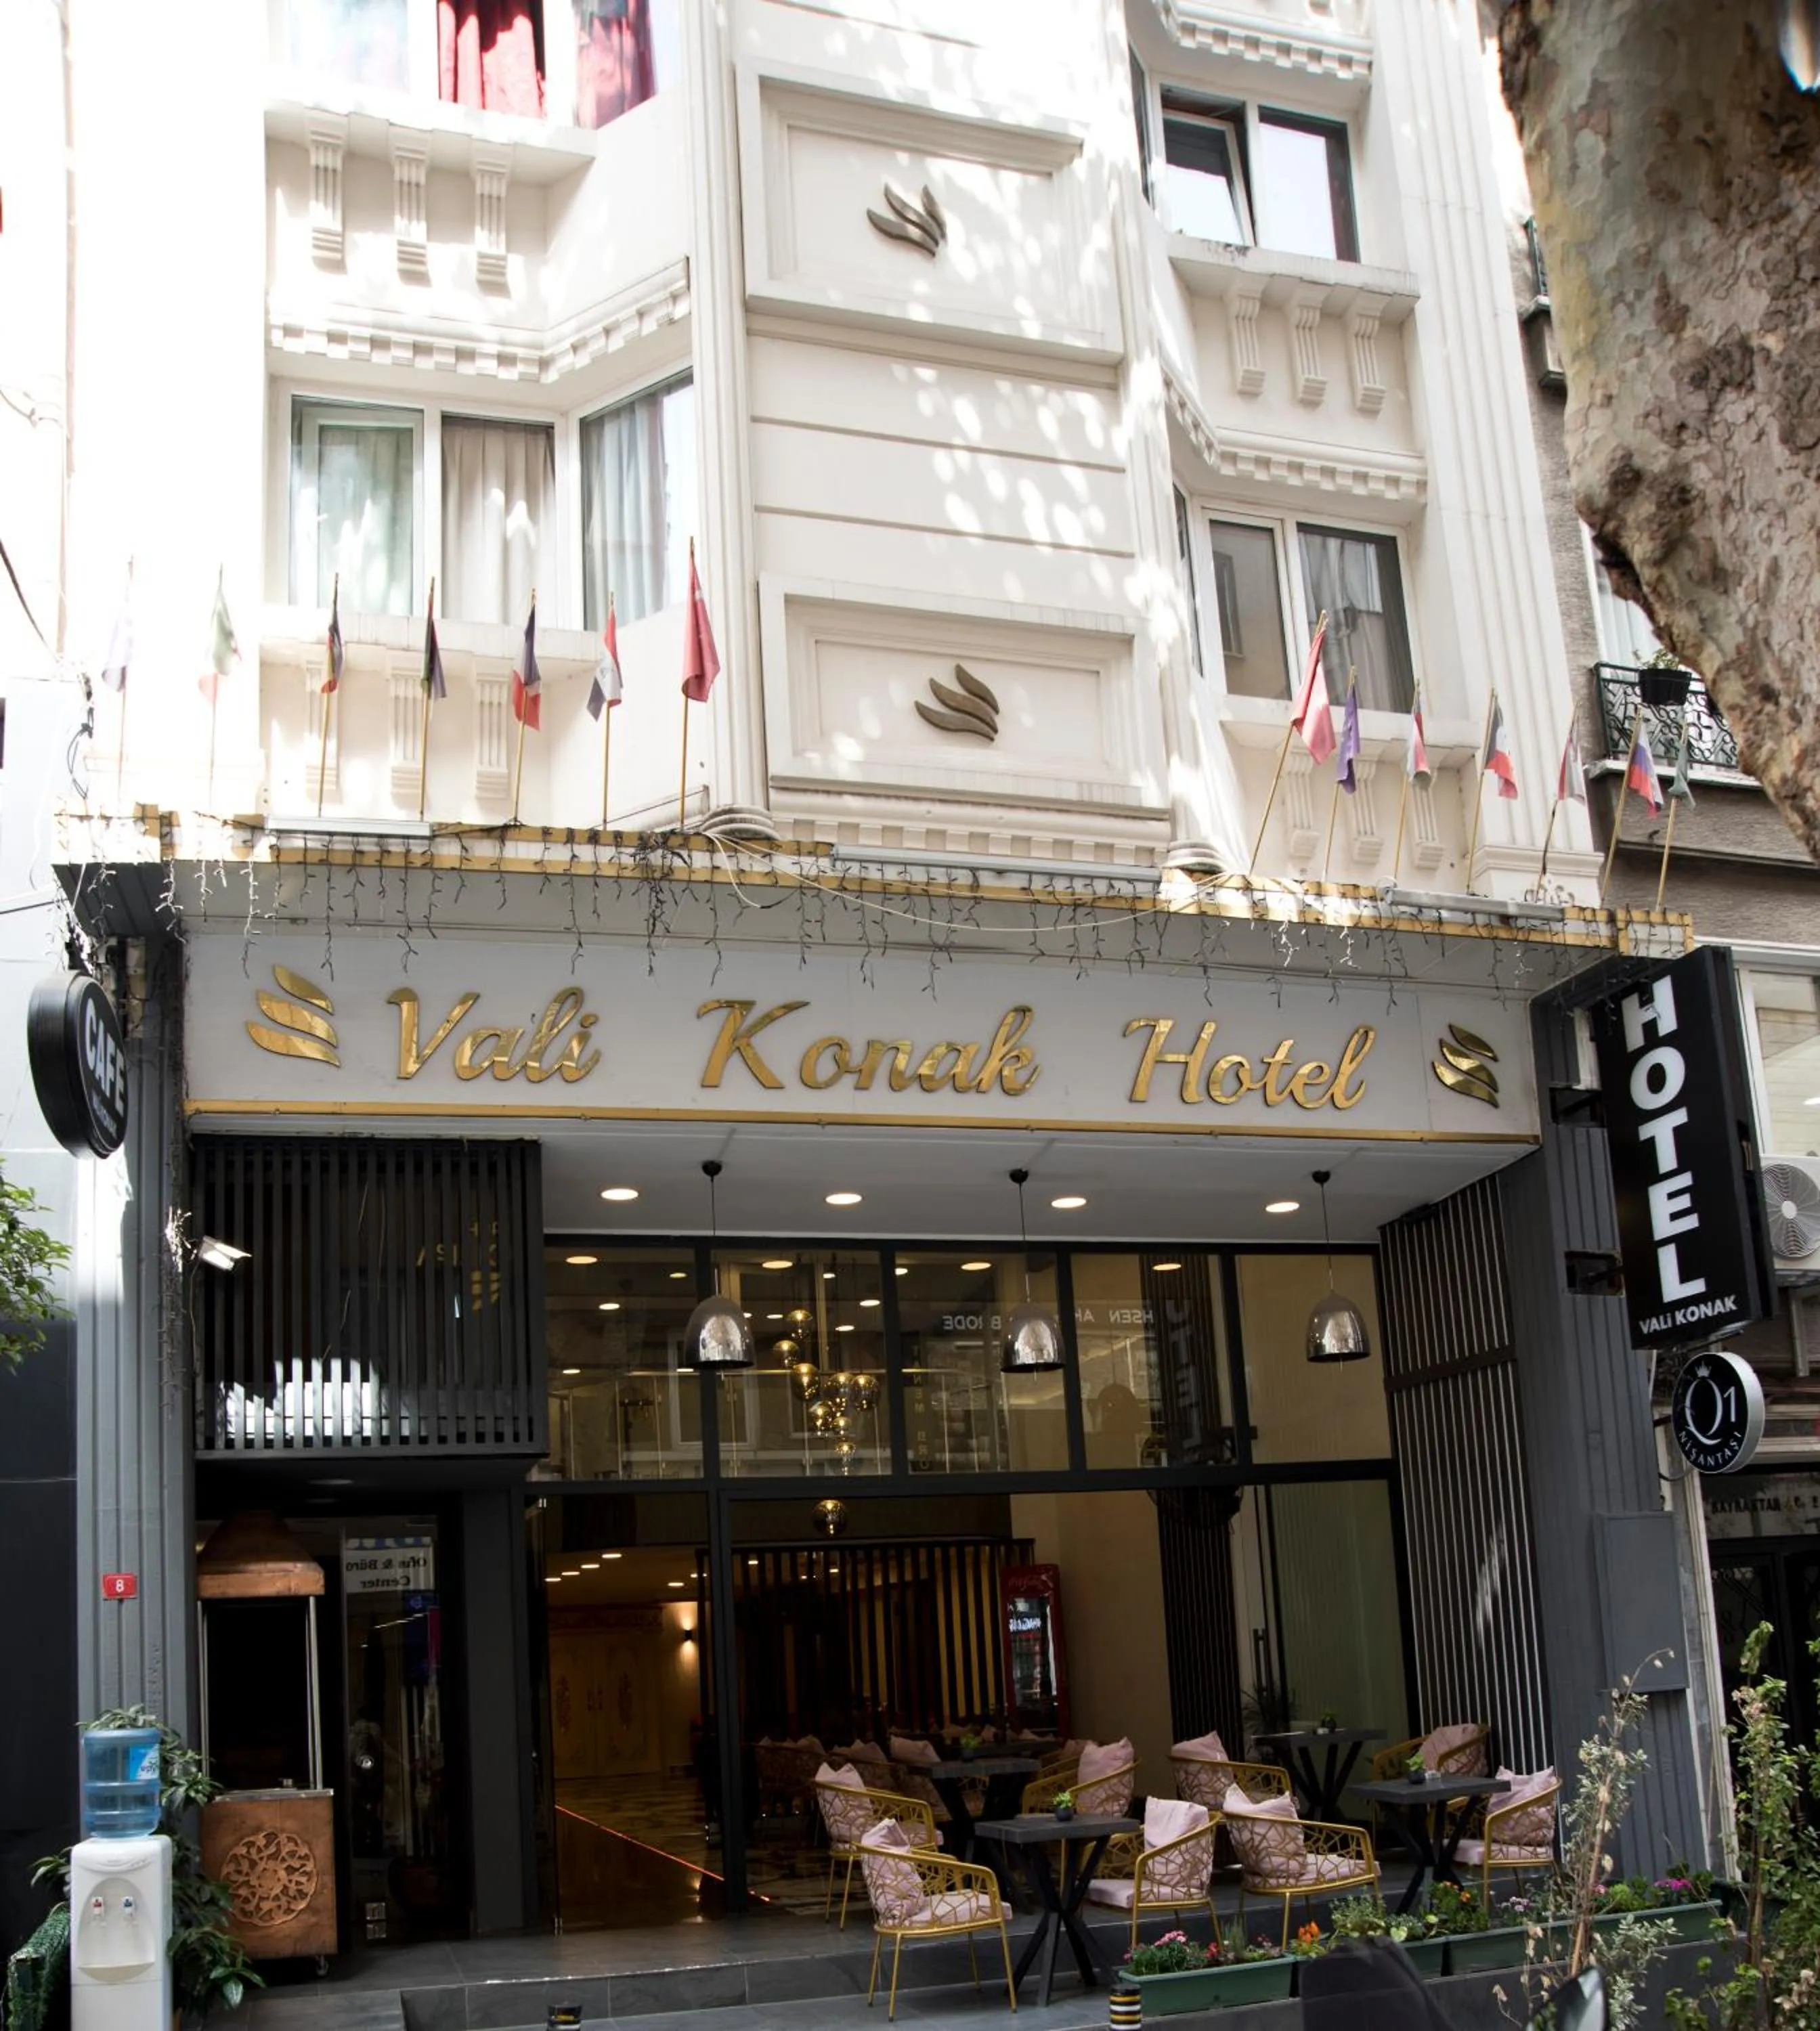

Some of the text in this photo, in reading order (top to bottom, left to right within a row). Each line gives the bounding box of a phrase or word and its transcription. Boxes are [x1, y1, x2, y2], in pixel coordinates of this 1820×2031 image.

[85, 997, 125, 1118] CAFE
[387, 986, 1376, 1110] Vali Konak Hotel
[1622, 974, 1706, 1304] HOTEL
[1675, 1294, 1738, 1326] KONAK
[1685, 1378, 1735, 1445] Q1
[116, 1579, 125, 1593] 8
